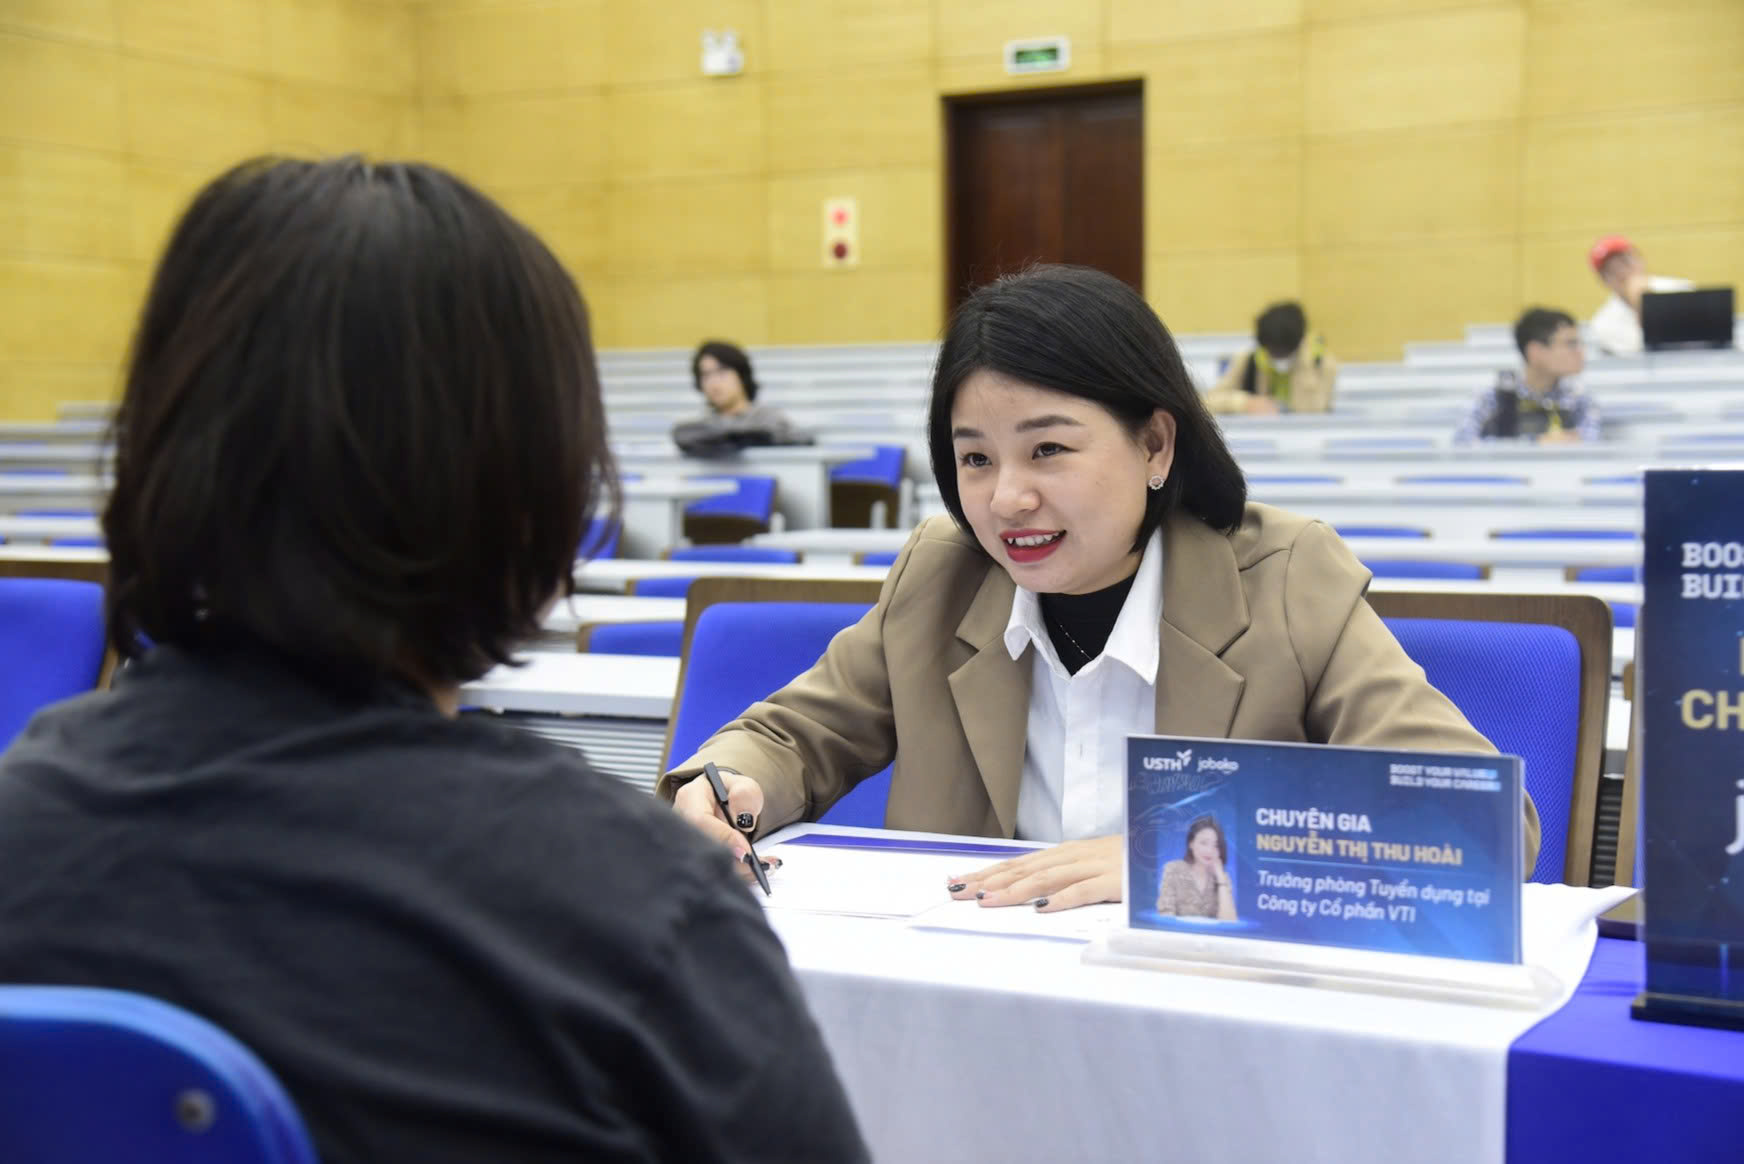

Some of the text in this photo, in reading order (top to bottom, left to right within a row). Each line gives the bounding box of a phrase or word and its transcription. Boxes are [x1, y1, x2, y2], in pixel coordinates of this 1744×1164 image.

[1681, 542, 1744, 568] BOO
[1681, 573, 1744, 599] BUI
[1143, 756, 1182, 771] USTH
[1256, 807, 1372, 833] CHUYÊN GIA
[1256, 831, 1463, 865] NGUYỄN THỊ THU HOÀI
[1257, 870, 1491, 908] Trưởng phòng Tuyển dụng tại
[1257, 893, 1298, 916] Công
[1301, 900, 1317, 917] ty
[1319, 897, 1342, 916] Cổ
[1388, 905, 1416, 922] VTI
